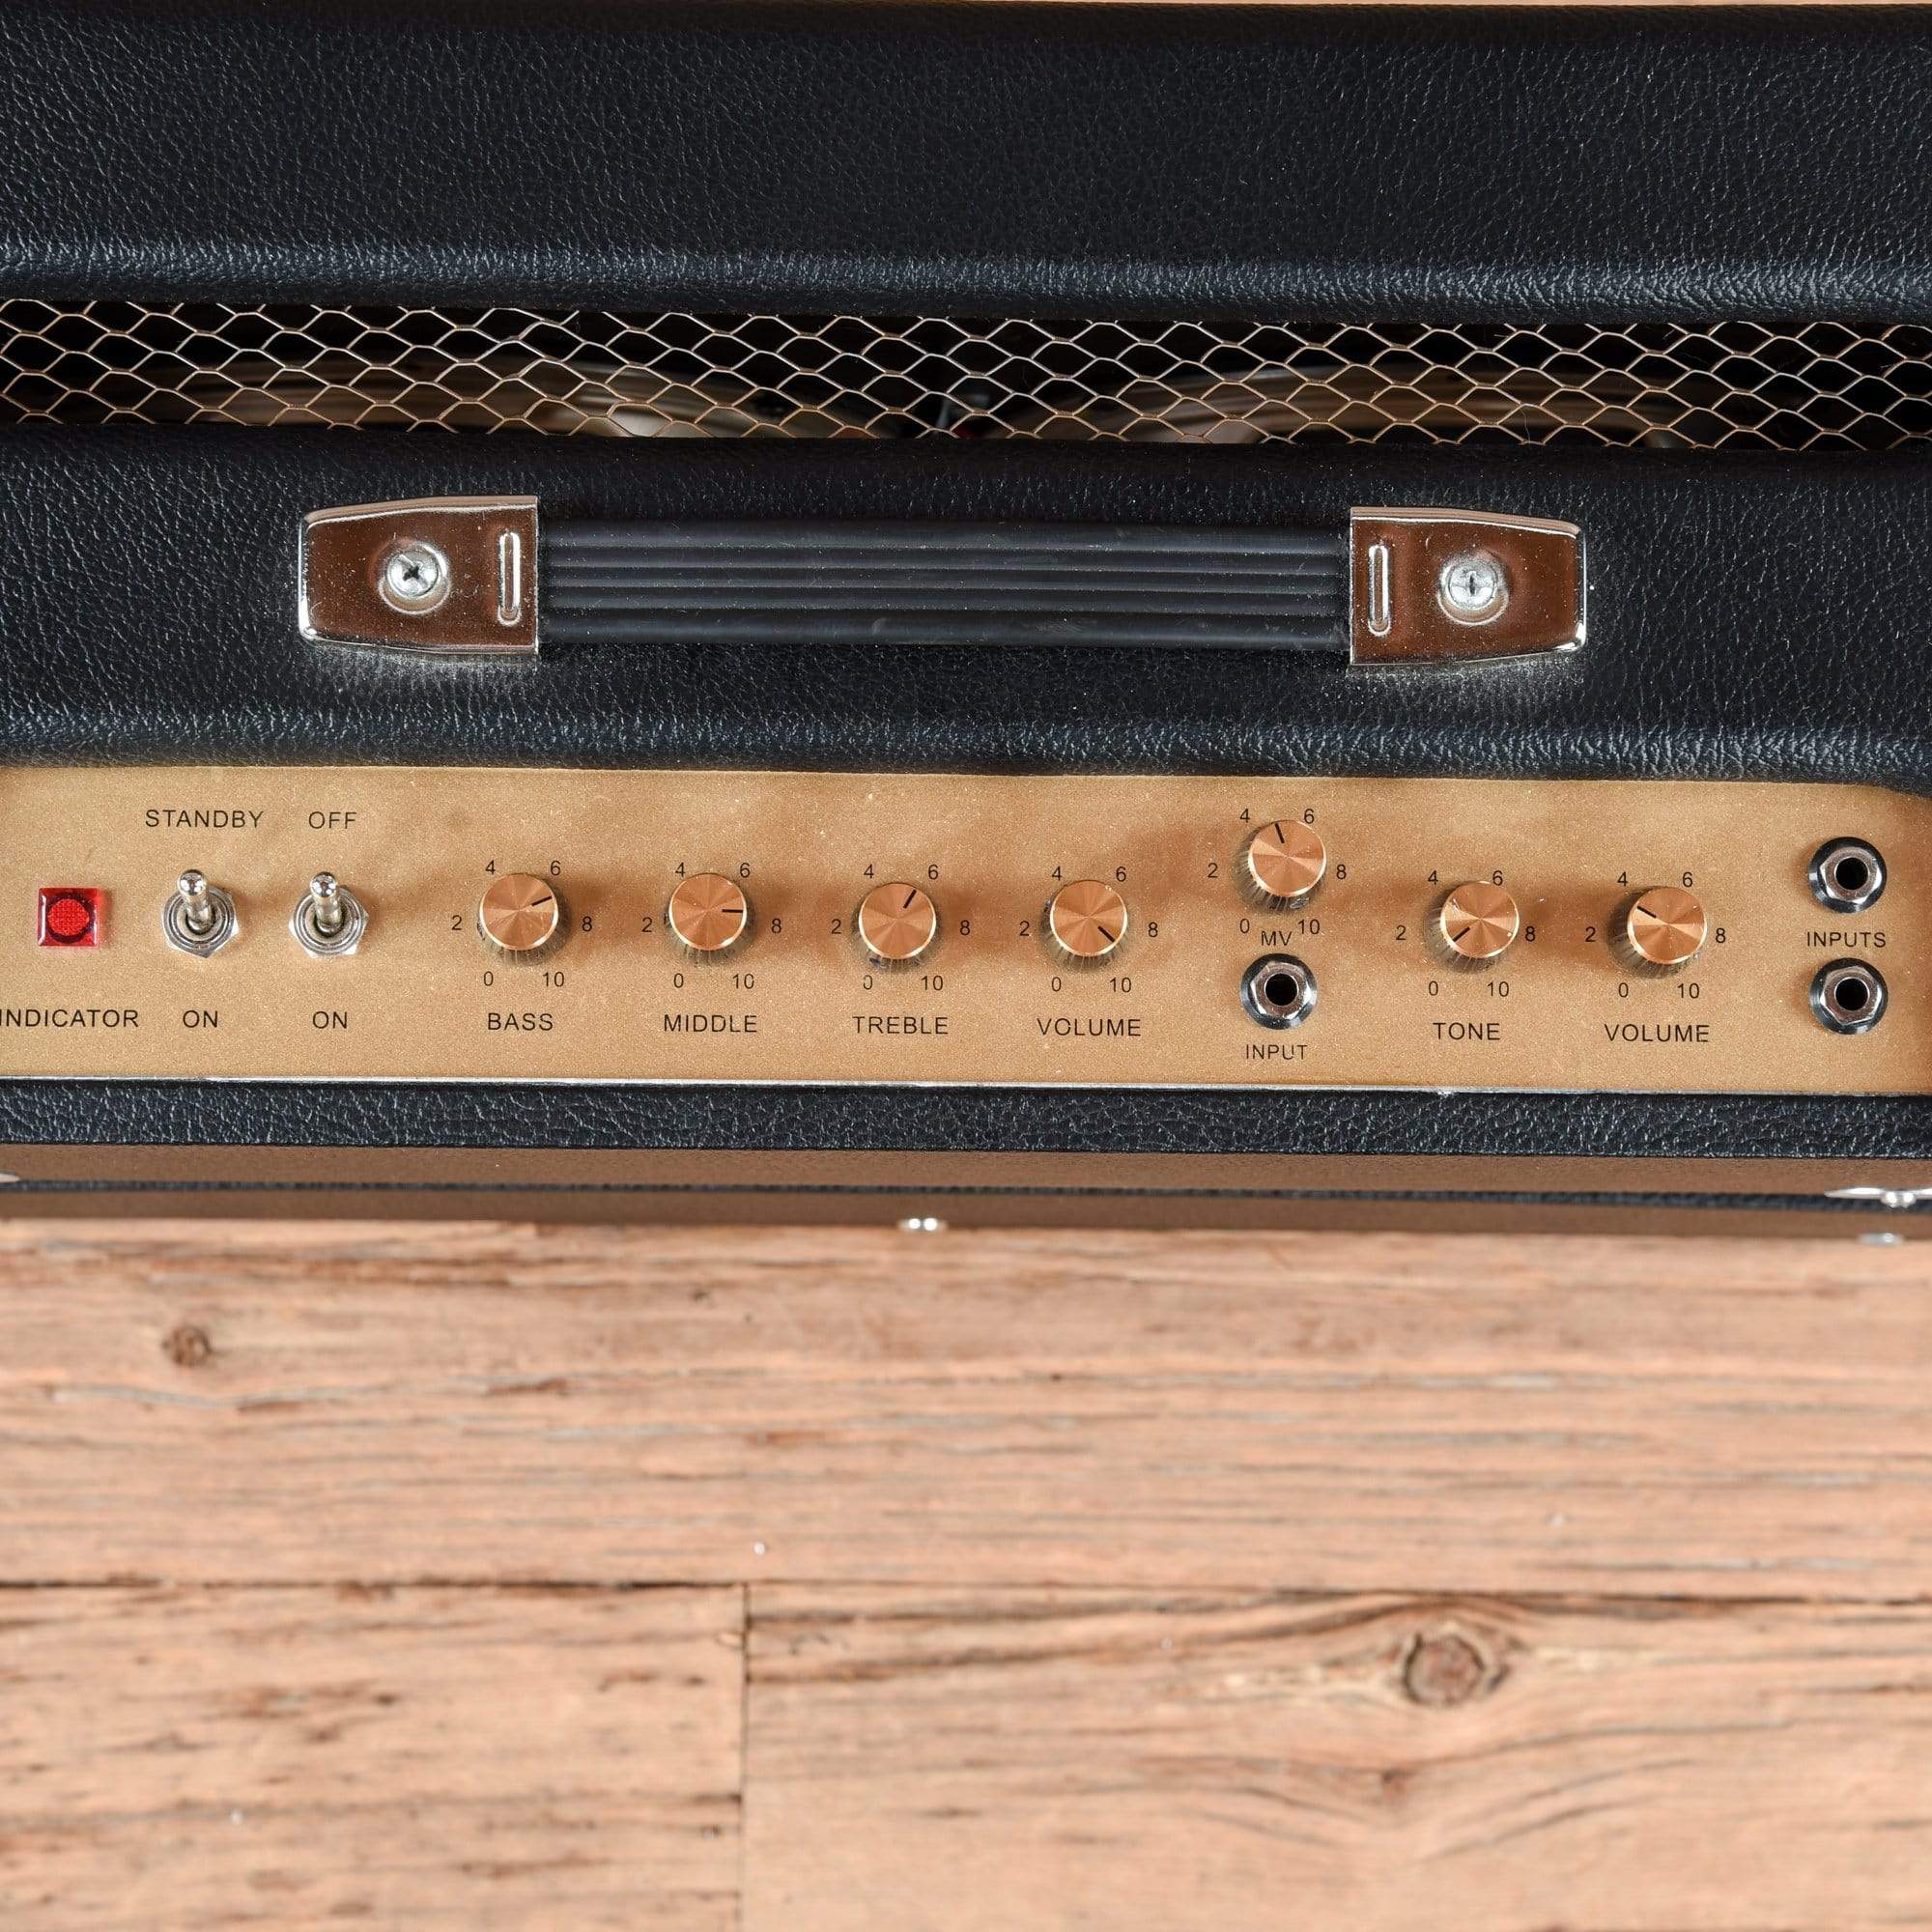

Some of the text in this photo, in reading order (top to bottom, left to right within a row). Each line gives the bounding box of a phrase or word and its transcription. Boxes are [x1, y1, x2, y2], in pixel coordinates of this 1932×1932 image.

[146, 810, 263, 828] STANDBY
[309, 811, 356, 829] OFF
[1239, 809, 1250, 823] 4
[1304, 809, 1314, 824] 6
[486, 861, 495, 874] 4
[551, 861, 560, 876] 6
[675, 863, 685, 876] 4
[740, 863, 751, 878] 6
[864, 865, 873, 878] 4
[928, 865, 938, 880] 6
[1052, 867, 1062, 880] 4
[1116, 867, 1126, 882] 6
[1208, 863, 1218, 878] 2
[1336, 864, 1347, 880] 8
[1428, 870, 1438, 885] 4
[1492, 870, 1503, 886] 6
[1617, 872, 1628, 887] 4
[1683, 871, 1692, 888] 6
[452, 915, 462, 930] 2
[582, 916, 592, 932] 8
[642, 917, 652, 932] 2
[771, 918, 781, 933] 8
[831, 919, 841, 934] 2
[959, 920, 970, 936] 8
[1019, 921, 1030, 936] 2
[1149, 922, 1158, 937] 8
[1239, 918, 1250, 934] 0
[1298, 919, 1320, 934] 10
[1262, 931, 1292, 946] MV
[1396, 925, 1406, 940] 2
[1525, 925, 1535, 942] 8
[1585, 926, 1596, 942] 2
[1716, 927, 1726, 943] 8
[1807, 932, 1886, 948] INPUTS
[484, 971, 494, 986] 0
[544, 972, 564, 986] 10
[673, 973, 684, 988] 0
[733, 974, 754, 989] 10
[863, 975, 873, 990] 0
[922, 976, 943, 990] 10
[1051, 977, 1062, 992] 0
[1111, 978, 1131, 992] 10
[1429, 980, 1438, 996] 0
[1488, 981, 1509, 997] 10
[1618, 982, 1629, 998] 0
[1678, 983, 1699, 999] 10
[0, 1009, 138, 1027] INDICATOR
[183, 1010, 217, 1028] ON
[313, 1011, 347, 1029] ON
[488, 1012, 553, 1031] BASS
[665, 1014, 756, 1033] MIDDLE
[853, 1016, 948, 1035] TREBLE
[1037, 1018, 1140, 1036] VOLUME
[1434, 1023, 1499, 1040] TONE
[1605, 1024, 1709, 1042] VOLUME
[1246, 1044, 1307, 1060] INPUT
